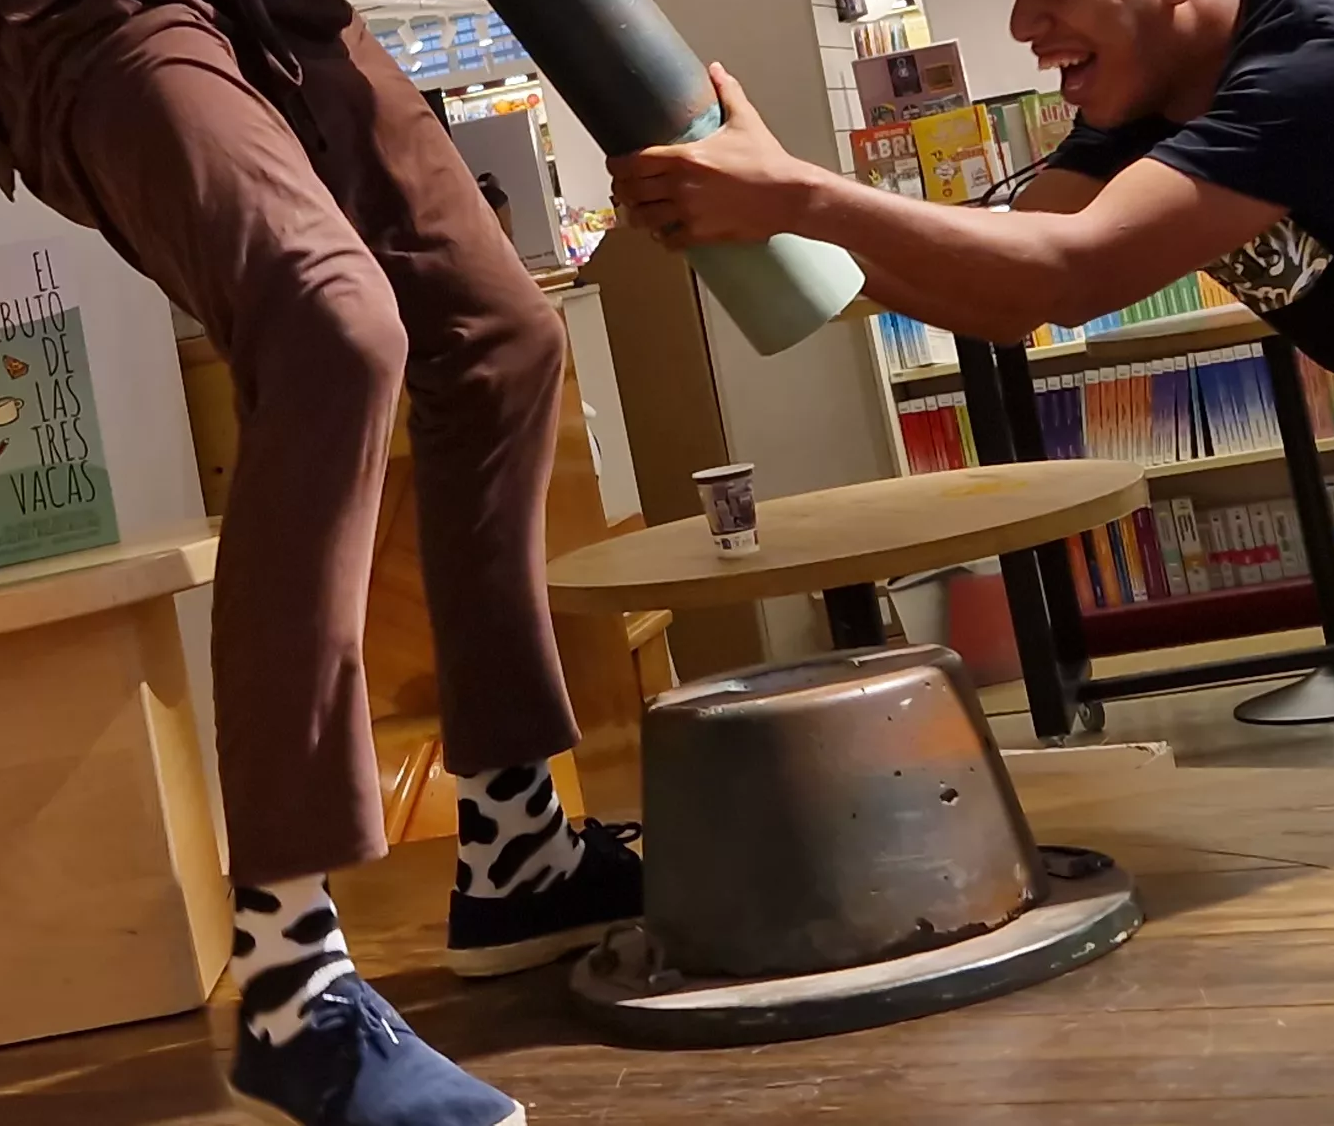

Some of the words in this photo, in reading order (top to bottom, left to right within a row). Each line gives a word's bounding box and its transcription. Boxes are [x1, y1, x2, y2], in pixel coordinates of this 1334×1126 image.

[33, 249, 60, 292] EL
[41, 333, 74, 377] DE
[35, 375, 81, 423] LAS
[30, 417, 89, 467] TRES
[9, 460, 96, 515] VACAS
